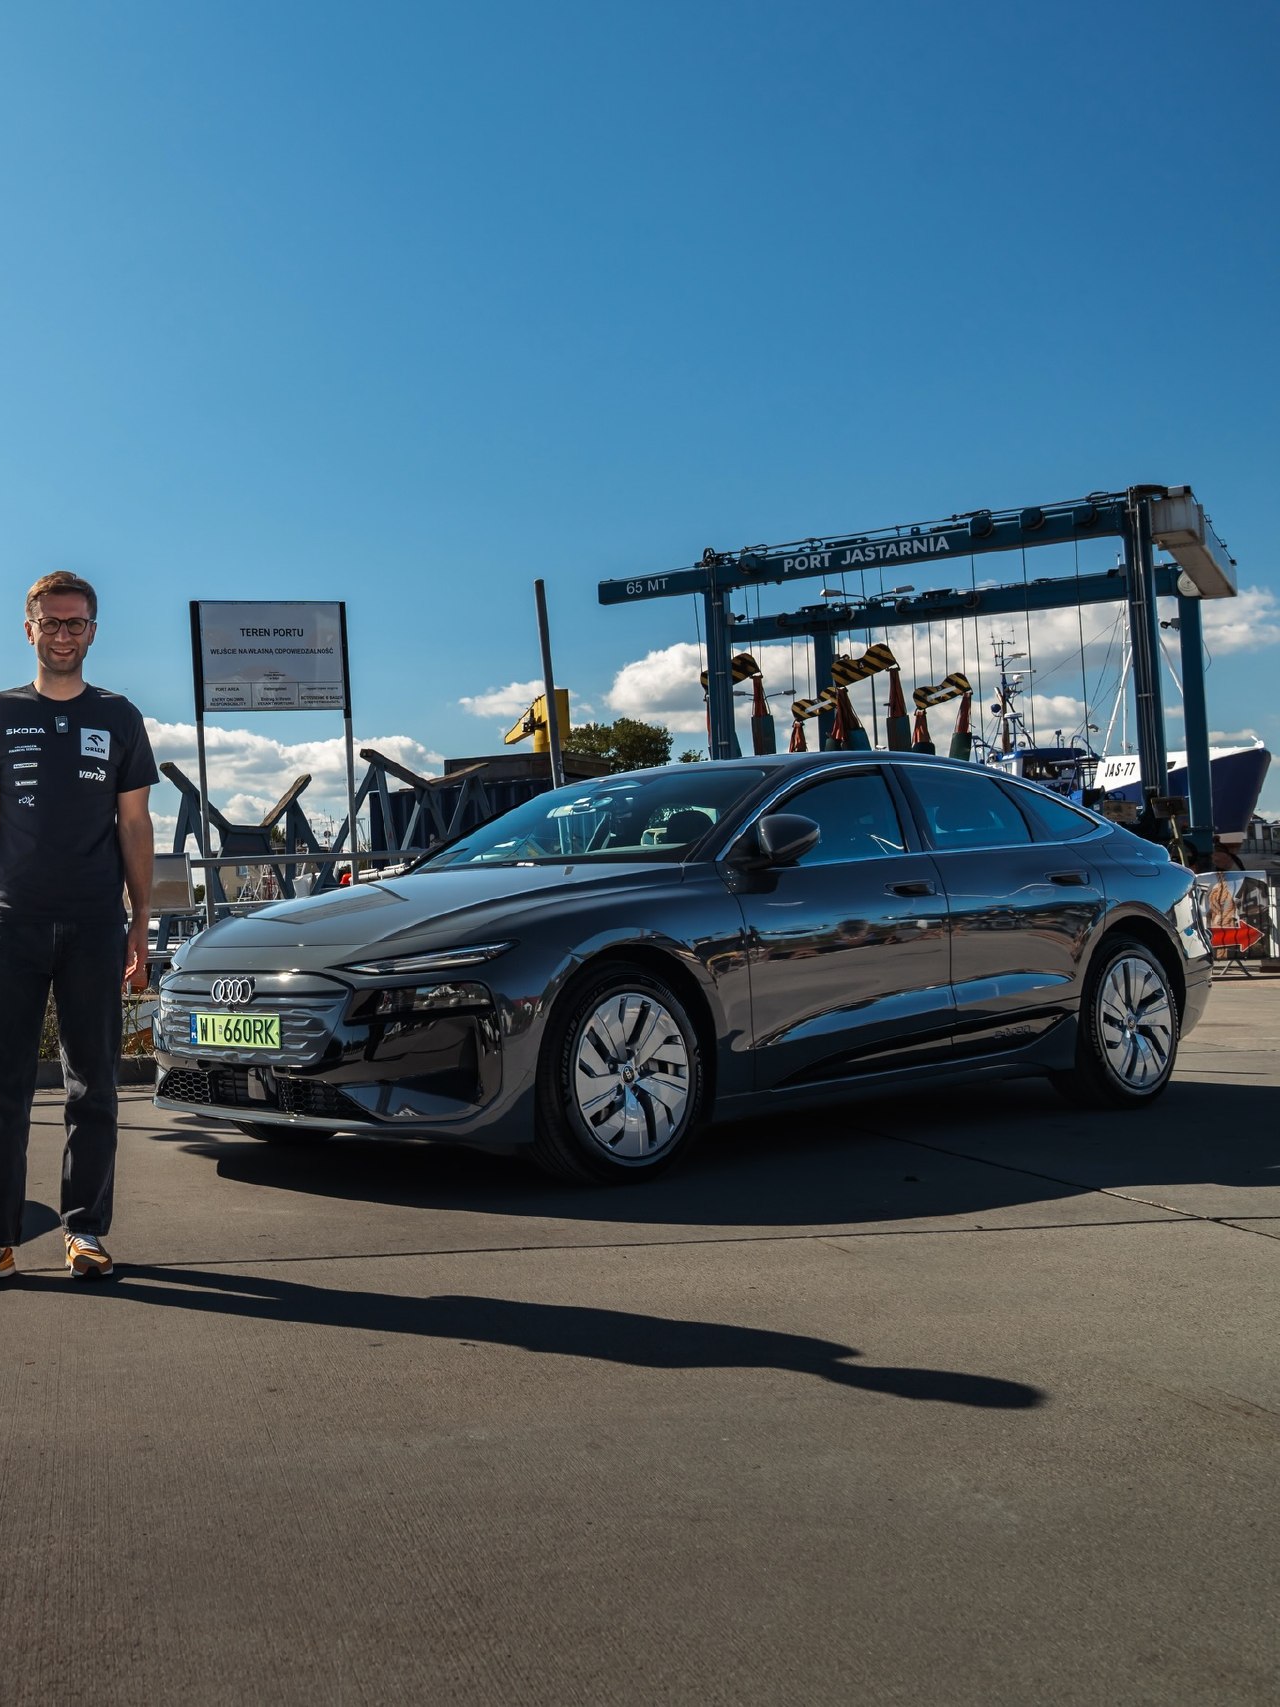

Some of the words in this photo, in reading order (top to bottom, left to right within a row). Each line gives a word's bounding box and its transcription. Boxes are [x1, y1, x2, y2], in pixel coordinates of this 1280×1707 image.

[783, 552, 832, 573] PORT
[841, 535, 950, 565] JASTARNIA
[626, 580, 643, 595] 65
[647, 578, 669, 592] MT
[240, 628, 270, 637] TEREN
[273, 628, 304, 637] PORTU
[85, 746, 106, 754] ORLEN
[78, 769, 107, 782] verva
[1105, 762, 1135, 777] JAS-77
[200, 1017, 216, 1042] WI
[223, 1018, 276, 1045] 660RK
